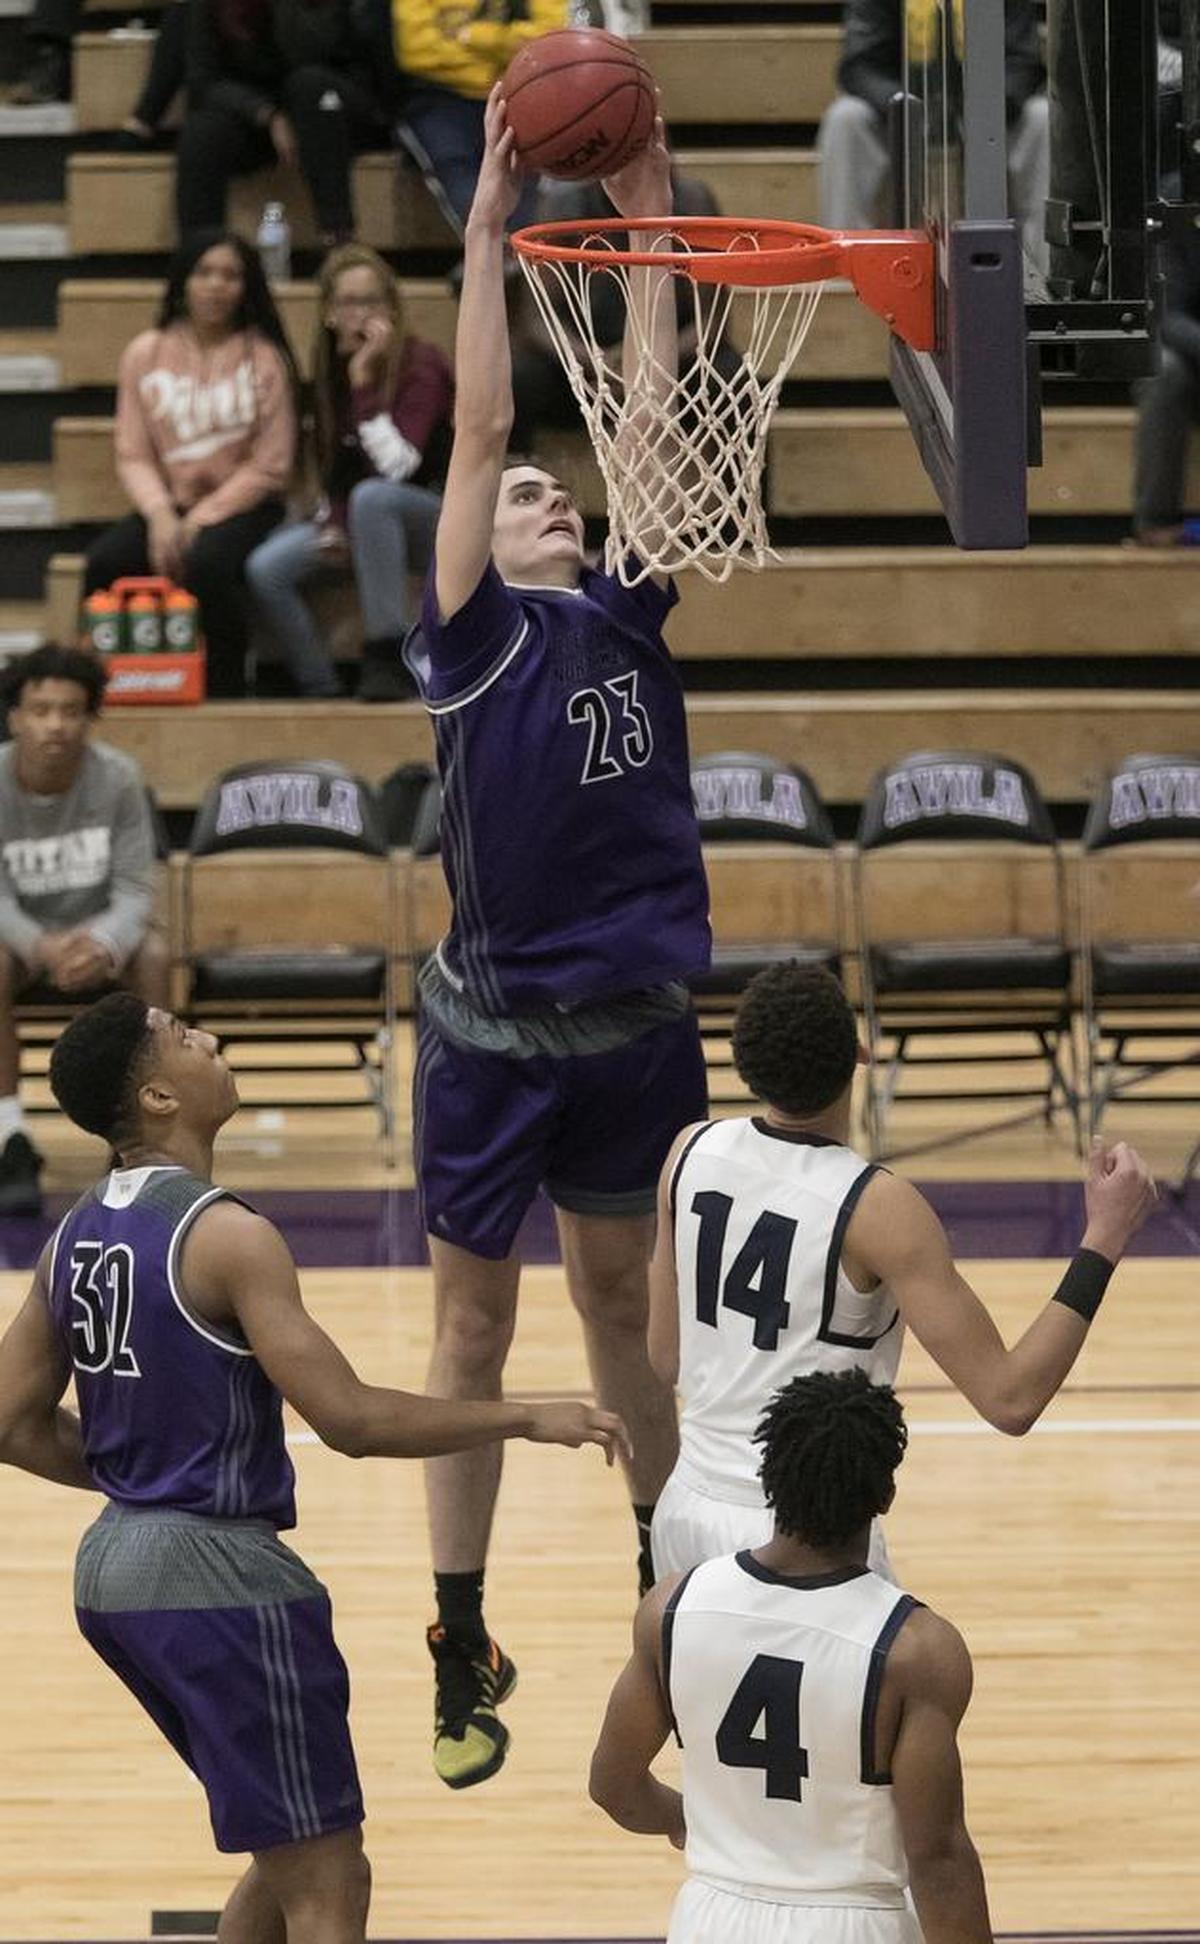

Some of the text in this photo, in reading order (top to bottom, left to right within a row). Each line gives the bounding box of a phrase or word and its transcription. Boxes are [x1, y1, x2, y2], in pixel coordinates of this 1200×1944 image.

[567, 670, 653, 785] 23
[215, 773, 364, 836] AVILA
[884, 764, 1029, 829] AVILA
[70, 1240, 142, 1378] 32
[690, 1190, 799, 1352] 14
[715, 1653, 809, 1804] 4
